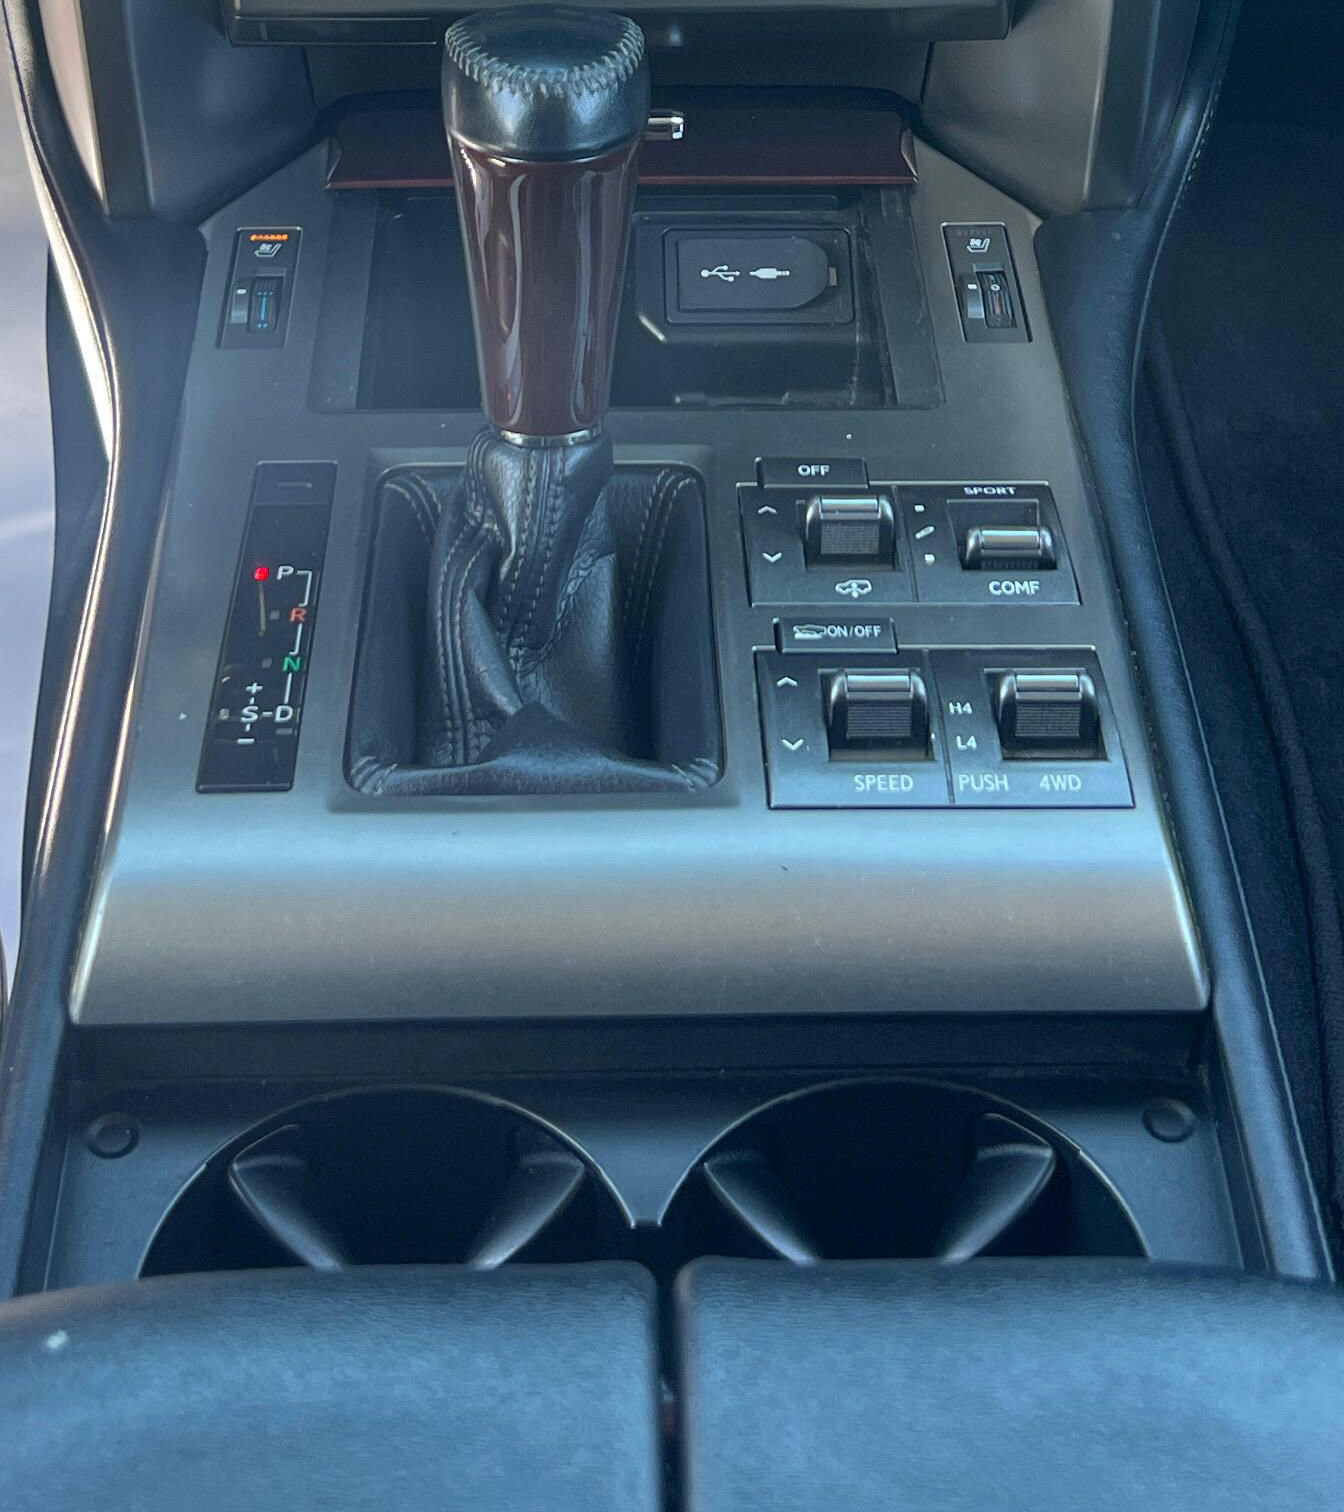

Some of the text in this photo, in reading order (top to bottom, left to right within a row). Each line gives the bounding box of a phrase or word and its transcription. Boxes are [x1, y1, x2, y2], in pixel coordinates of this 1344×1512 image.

[797, 464, 831, 477] OFF
[963, 486, 1017, 496] SPORT
[276, 565, 295, 581] P
[988, 580, 1041, 596] COMF
[289, 607, 307, 622] R
[827, 624, 882, 638] ON/OFF
[282, 656, 302, 673] N
[948, 701, 974, 715] H4
[956, 735, 978, 751] L4
[853, 774, 914, 792] SPEED
[958, 773, 1082, 792] PUSH 4WD
